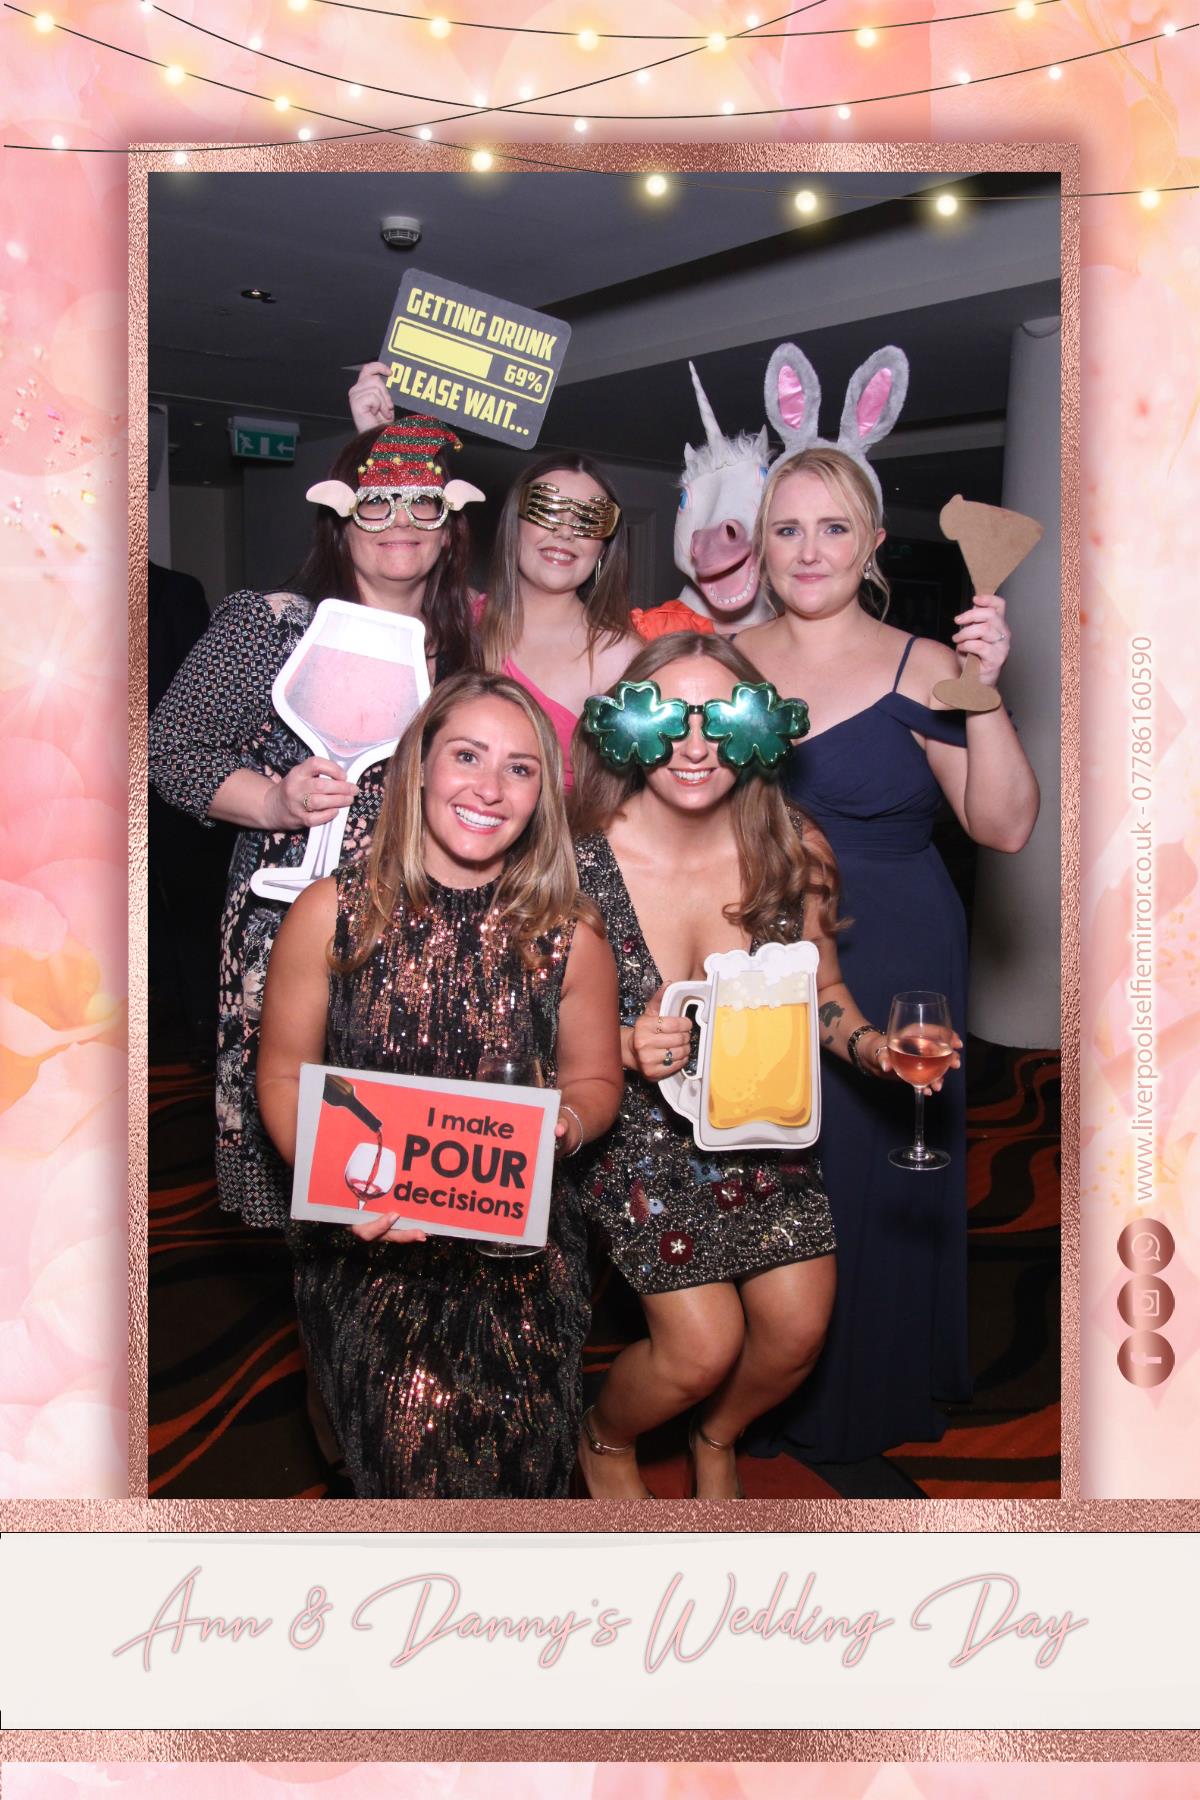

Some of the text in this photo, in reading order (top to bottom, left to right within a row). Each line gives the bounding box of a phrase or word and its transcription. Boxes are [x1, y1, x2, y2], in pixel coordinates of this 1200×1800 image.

[406, 287, 558, 361] GETTING DRUNK
[386, 361, 530, 436] PLEASE WAIT...
[503, 363, 543, 393] 69%
[427, 1107, 514, 1139] I make
[401, 1133, 527, 1189] POUR
[393, 1181, 524, 1220] decisions
